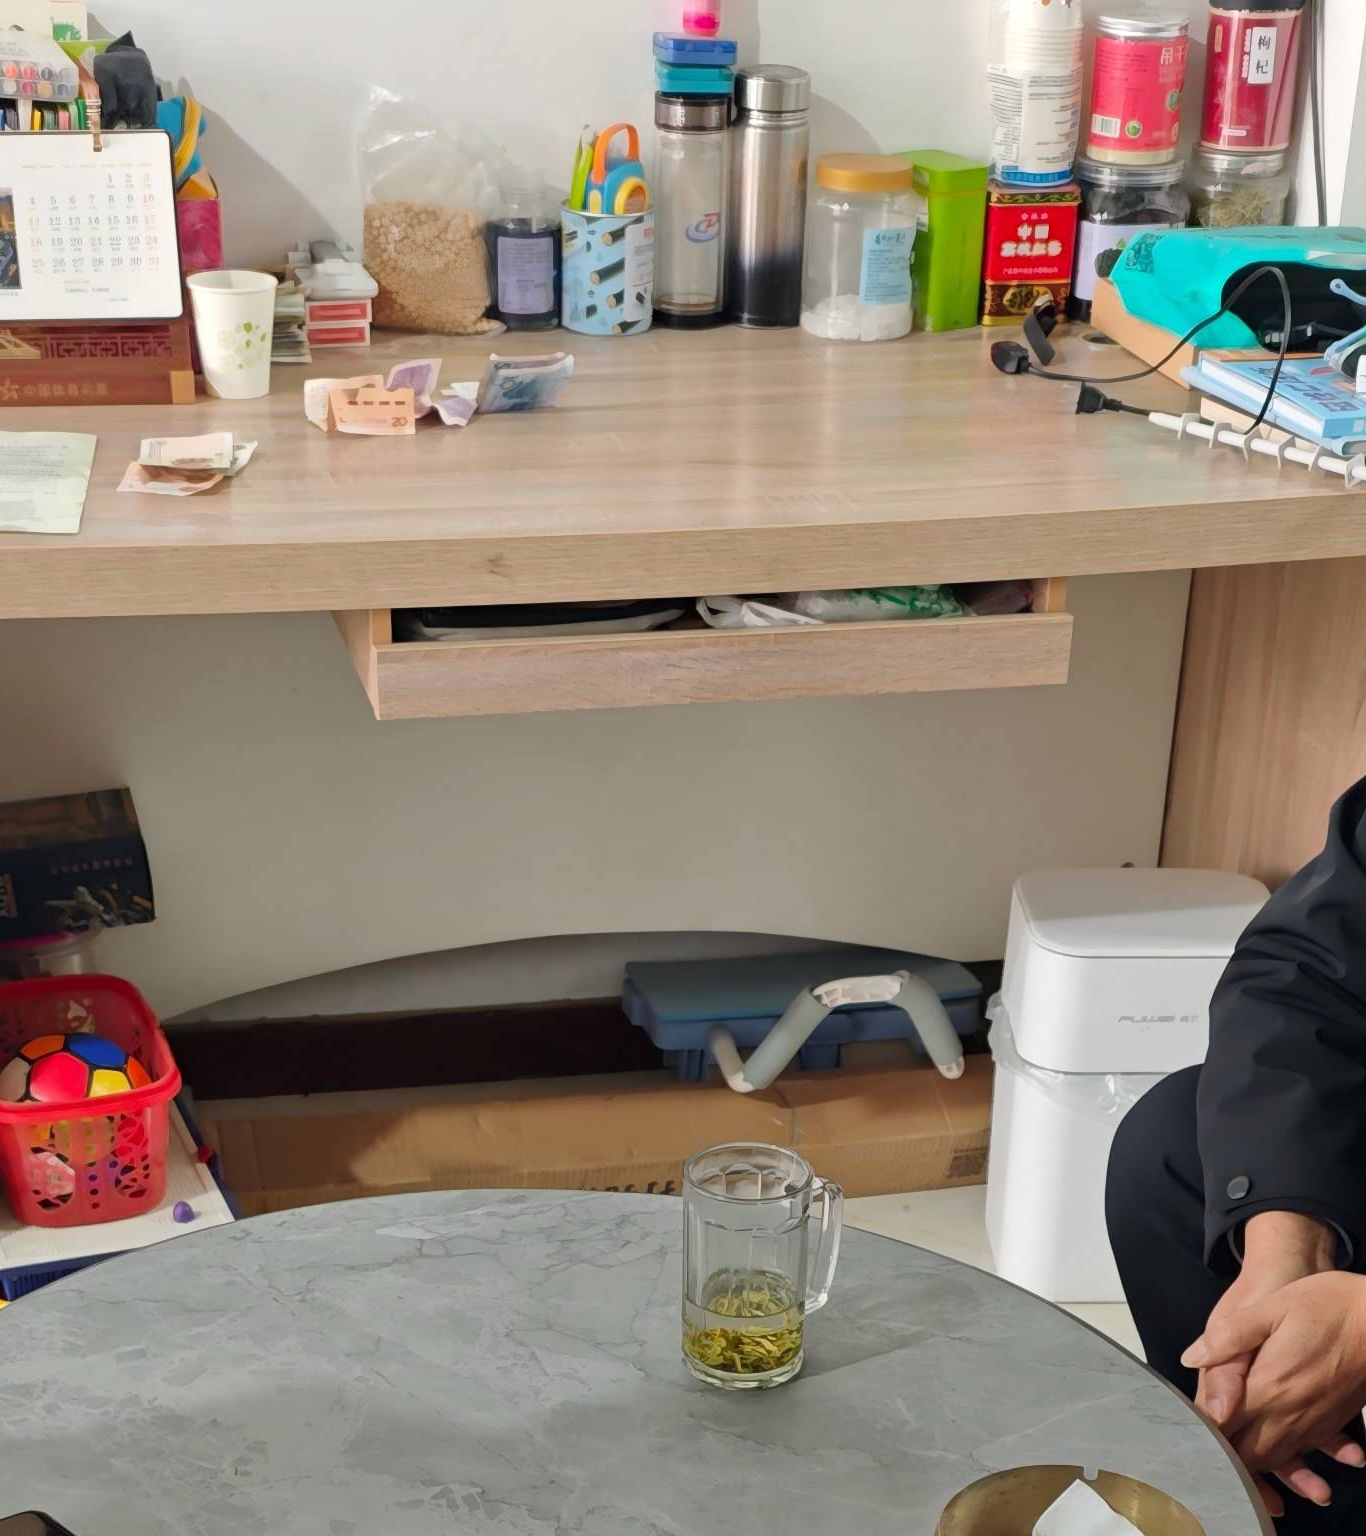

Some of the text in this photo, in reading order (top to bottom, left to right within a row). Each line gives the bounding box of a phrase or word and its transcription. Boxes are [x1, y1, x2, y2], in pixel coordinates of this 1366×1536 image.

[49, 216, 61, 225] 12
[69, 216, 80, 225] 13
[88, 216, 99, 225] 14
[107, 216, 119, 225] 15
[126, 216, 138, 224] 16
[51, 238, 63, 246] 19
[70, 237, 82, 246] 20
[90, 237, 102, 246] 21
[109, 237, 121, 245] 22
[127, 236, 140, 245] 23
[53, 259, 65, 267] 26
[72, 259, 84, 267] 27
[92, 258, 104, 267] 28
[111, 258, 123, 266] 29
[129, 258, 141, 266] 30
